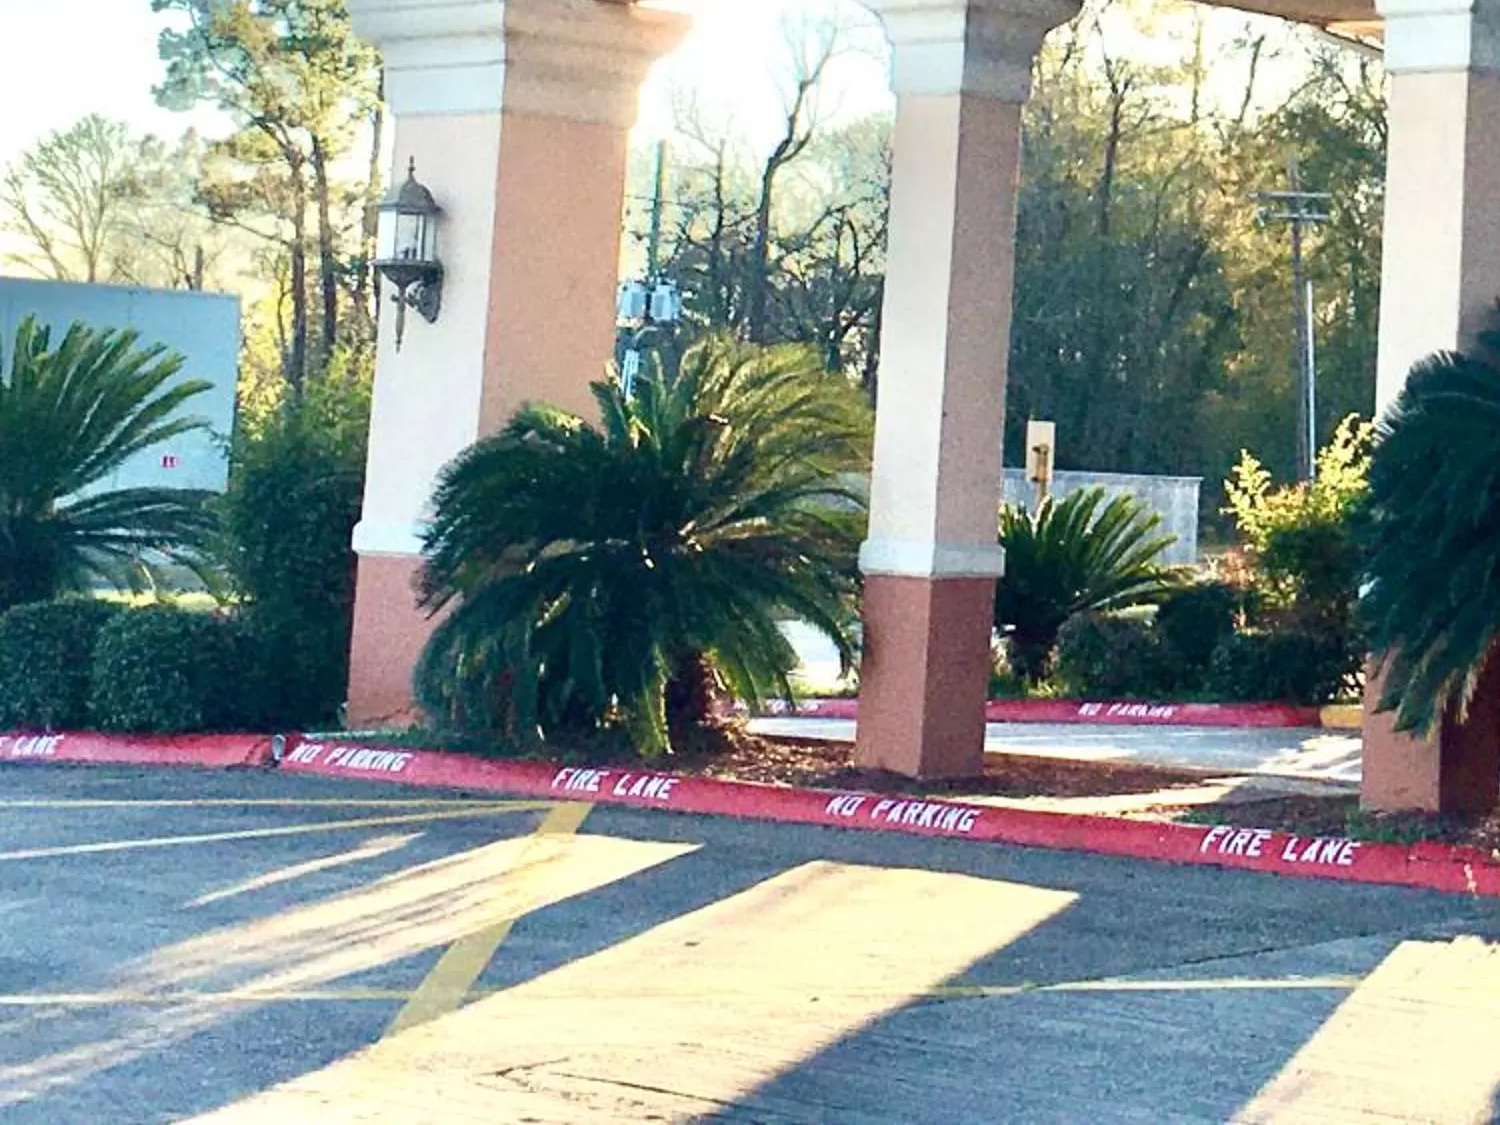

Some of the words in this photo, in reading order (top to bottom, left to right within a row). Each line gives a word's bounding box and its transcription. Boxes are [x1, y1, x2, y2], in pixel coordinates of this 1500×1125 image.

[287, 742, 324, 763] NO
[323, 747, 414, 772] PARKING
[551, 768, 610, 792] FIRE
[612, 774, 680, 800] LANE
[825, 795, 865, 816] NO
[871, 799, 981, 832] PARKING
[1200, 825, 1272, 856] FIRE
[1281, 835, 1361, 865] LANE
